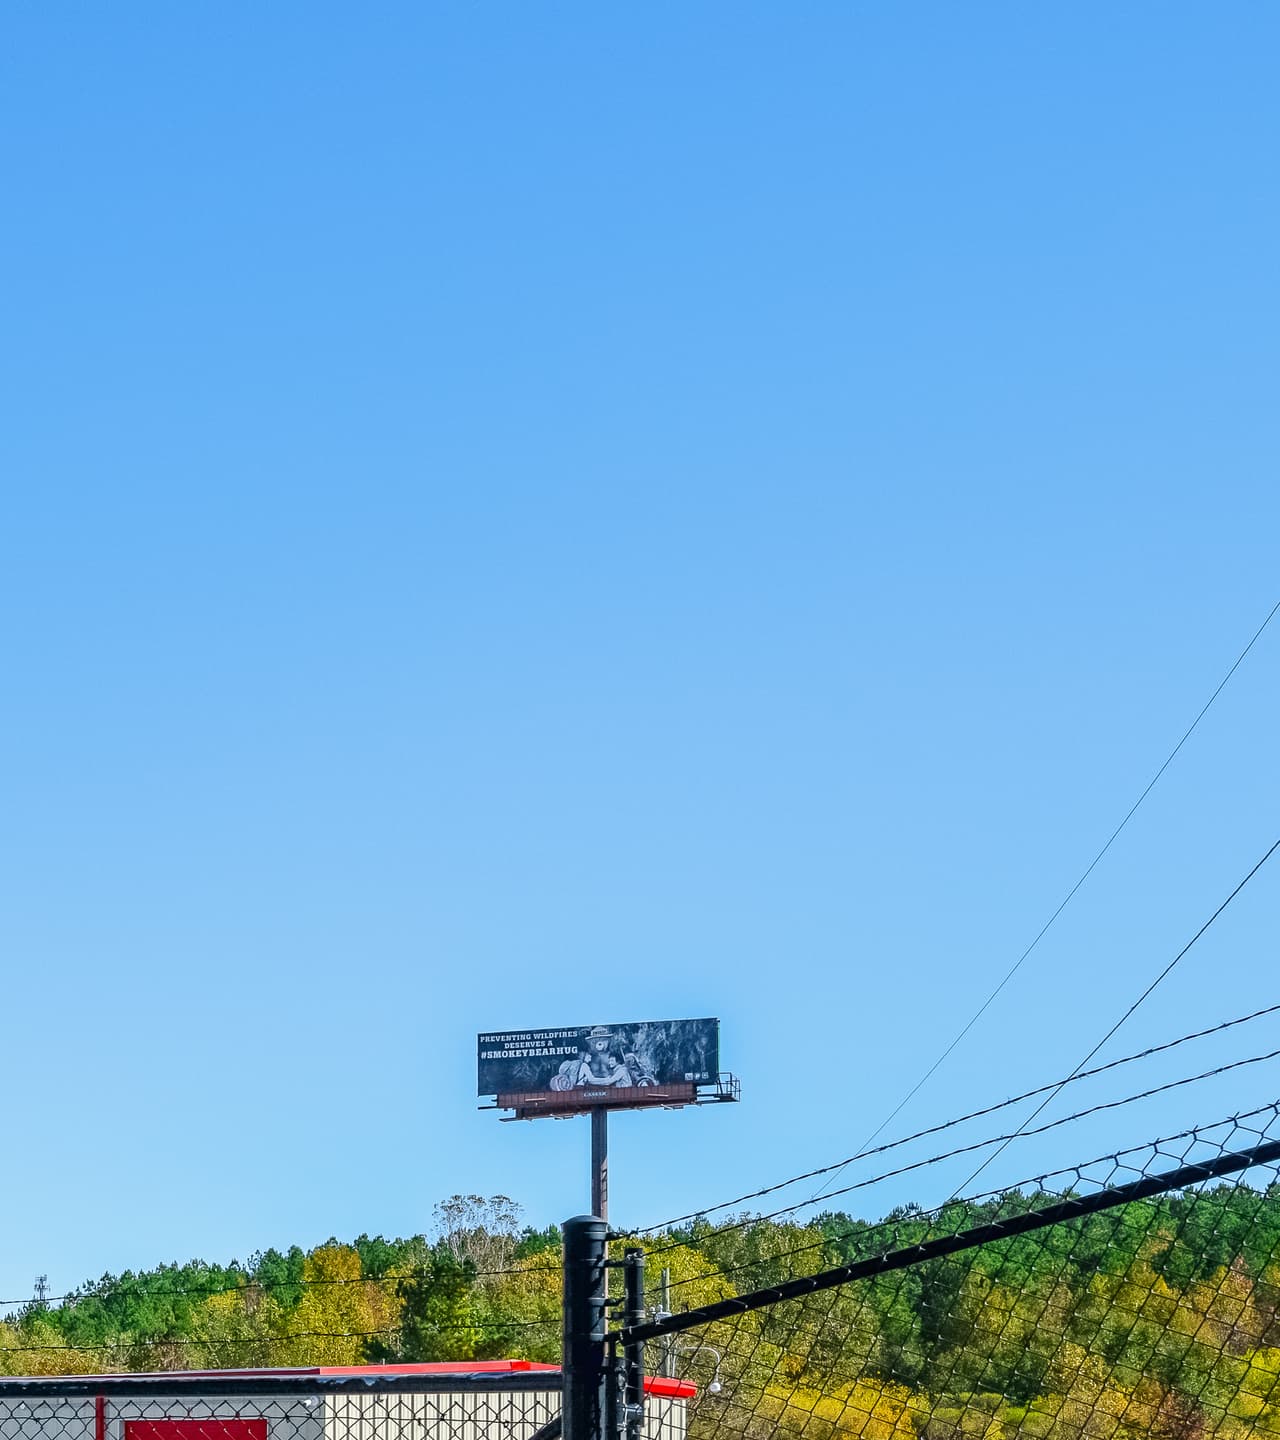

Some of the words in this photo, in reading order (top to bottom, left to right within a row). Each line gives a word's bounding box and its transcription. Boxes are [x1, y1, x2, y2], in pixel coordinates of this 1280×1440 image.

[480, 1033, 531, 1043] PREVENTING
[533, 1031, 578, 1040] WILDFIRES
[504, 1040, 546, 1049] DESERVES
[481, 1046, 578, 1059] #SMOKEYBEARHUG
